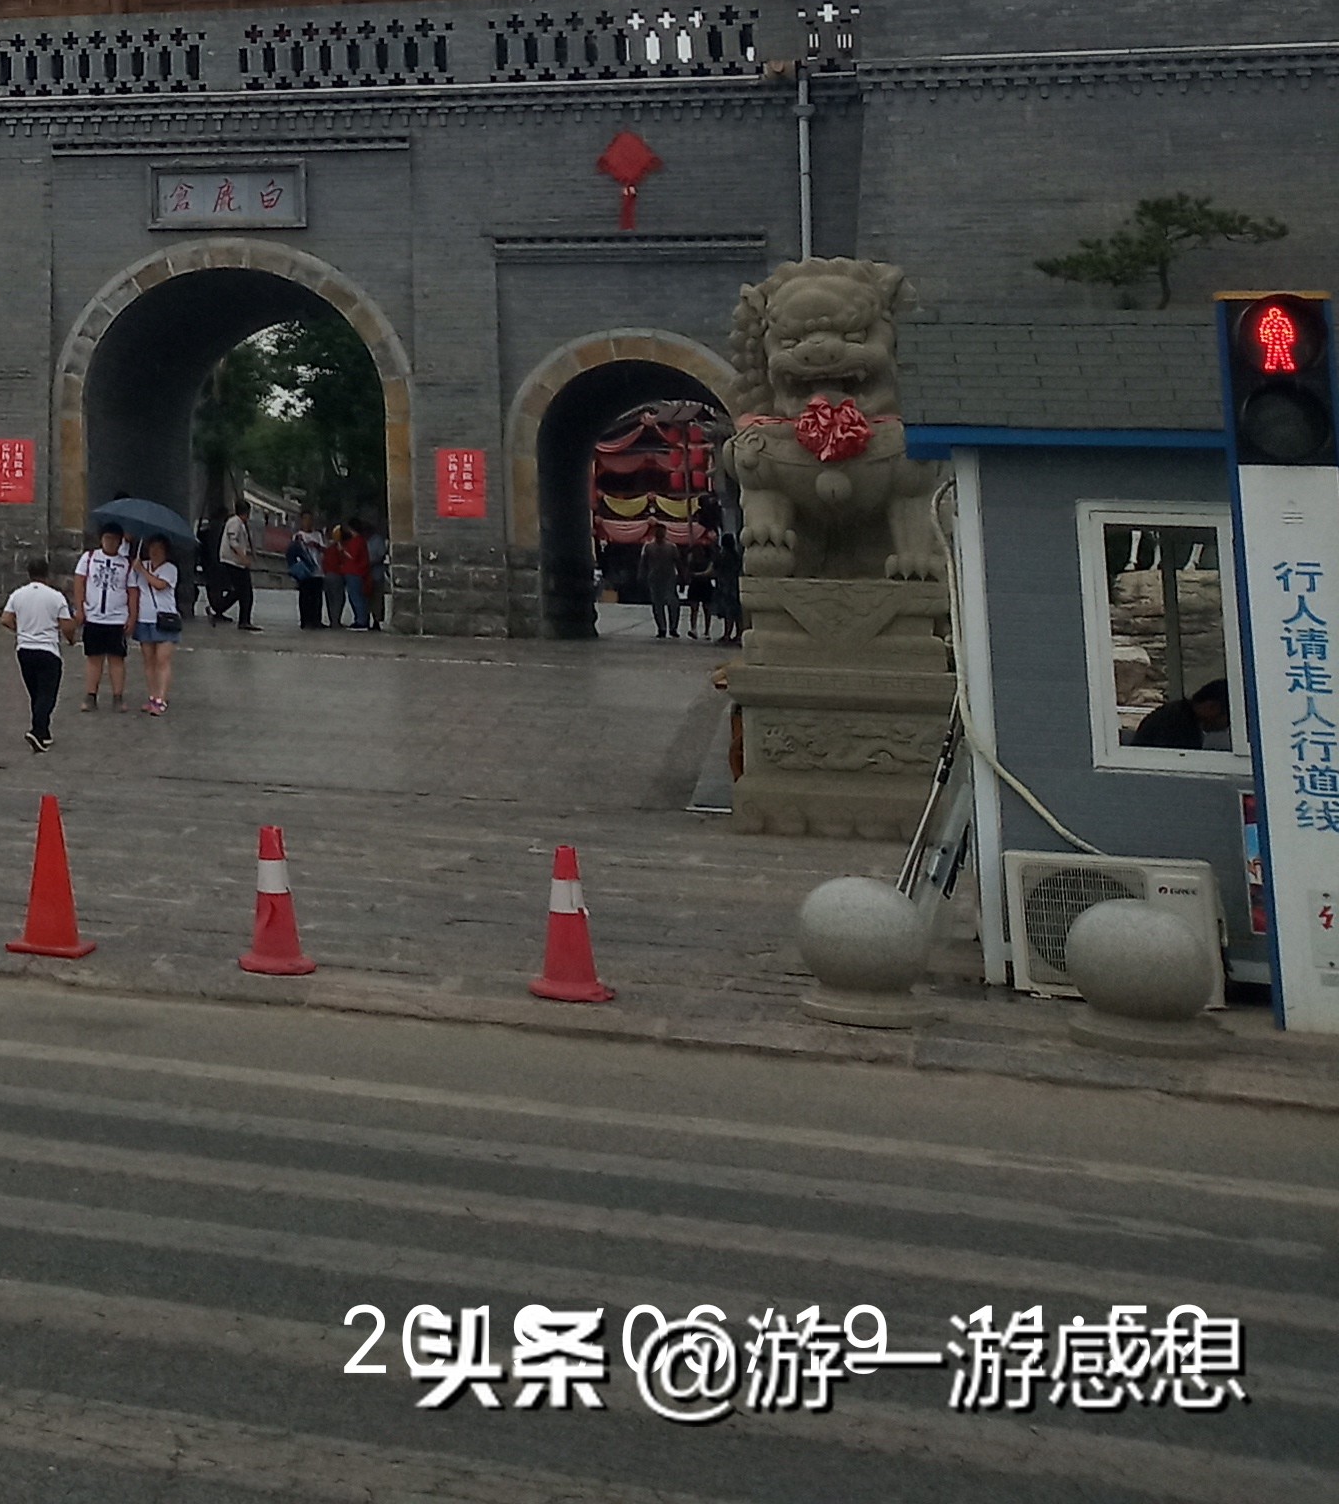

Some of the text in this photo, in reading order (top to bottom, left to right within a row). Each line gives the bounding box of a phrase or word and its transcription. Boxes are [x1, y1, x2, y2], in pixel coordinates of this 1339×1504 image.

[1273, 560, 1339, 834] 行人请走人行道线
